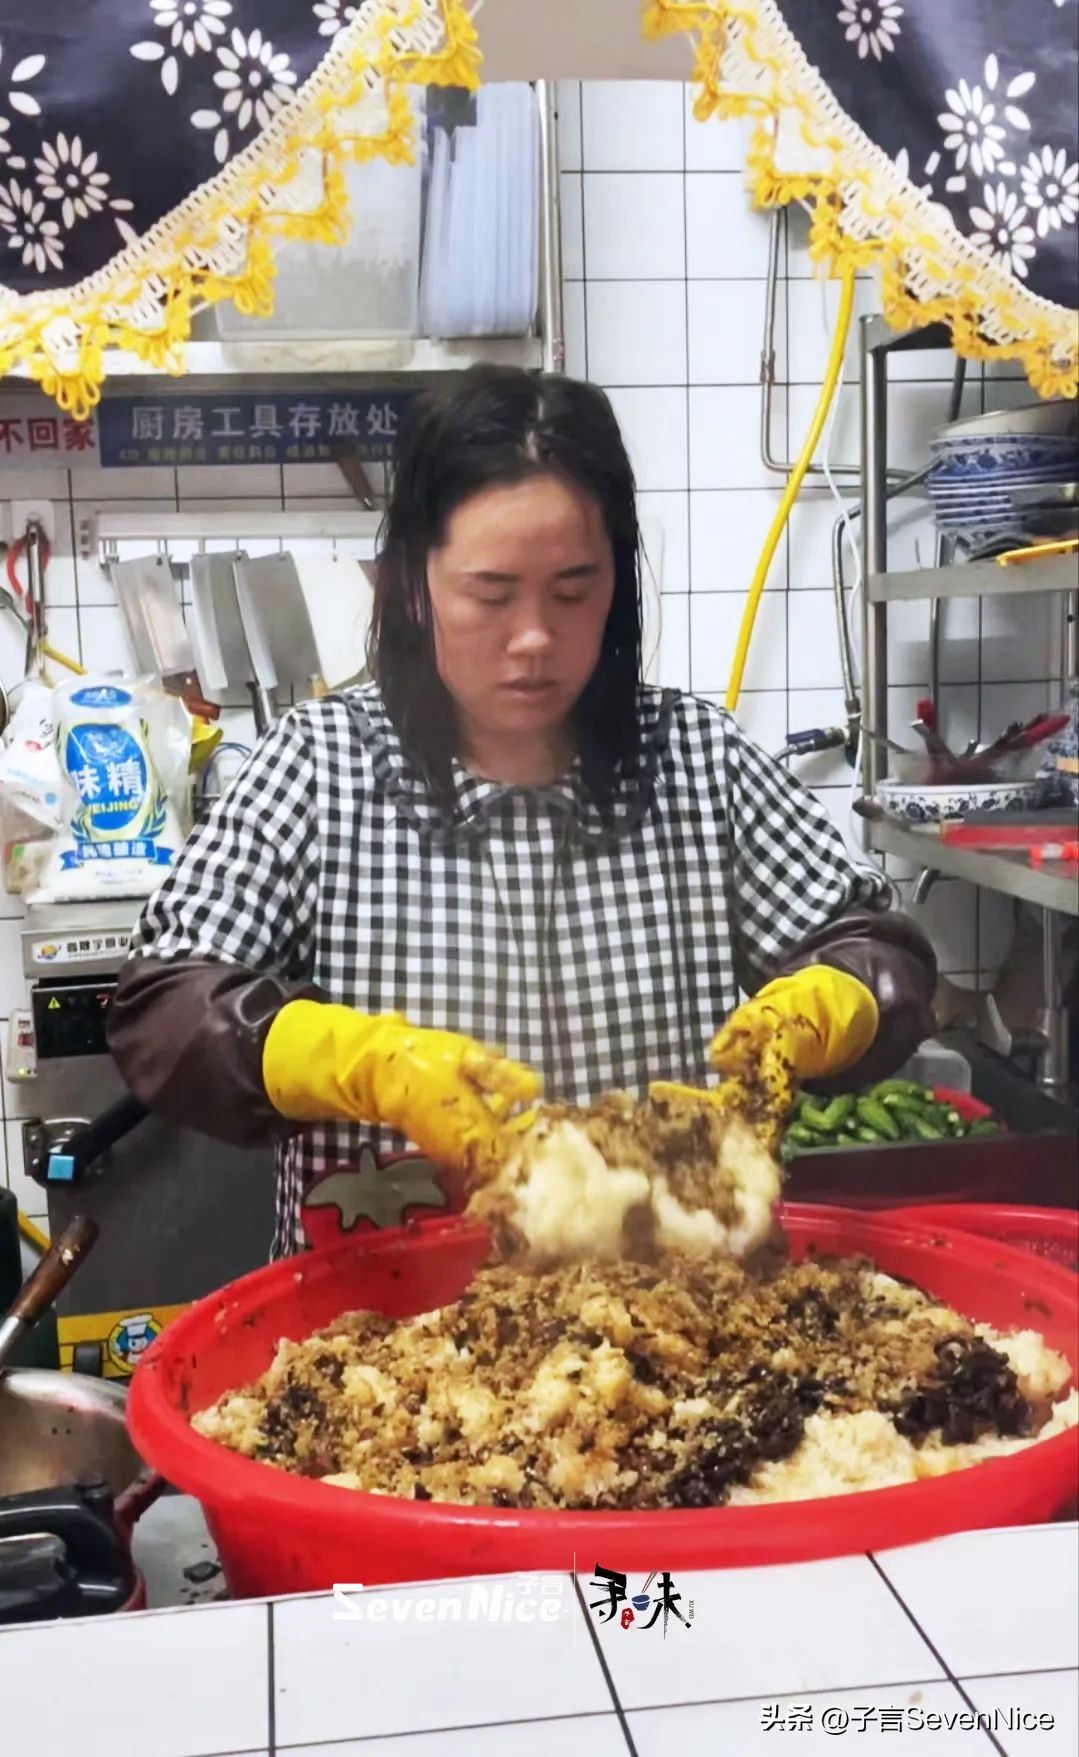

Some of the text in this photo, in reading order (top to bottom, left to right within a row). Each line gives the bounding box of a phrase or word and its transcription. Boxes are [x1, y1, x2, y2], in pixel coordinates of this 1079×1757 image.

[132, 403, 398, 440] 厨房工具存放处
[71, 757, 143, 799] 味精
